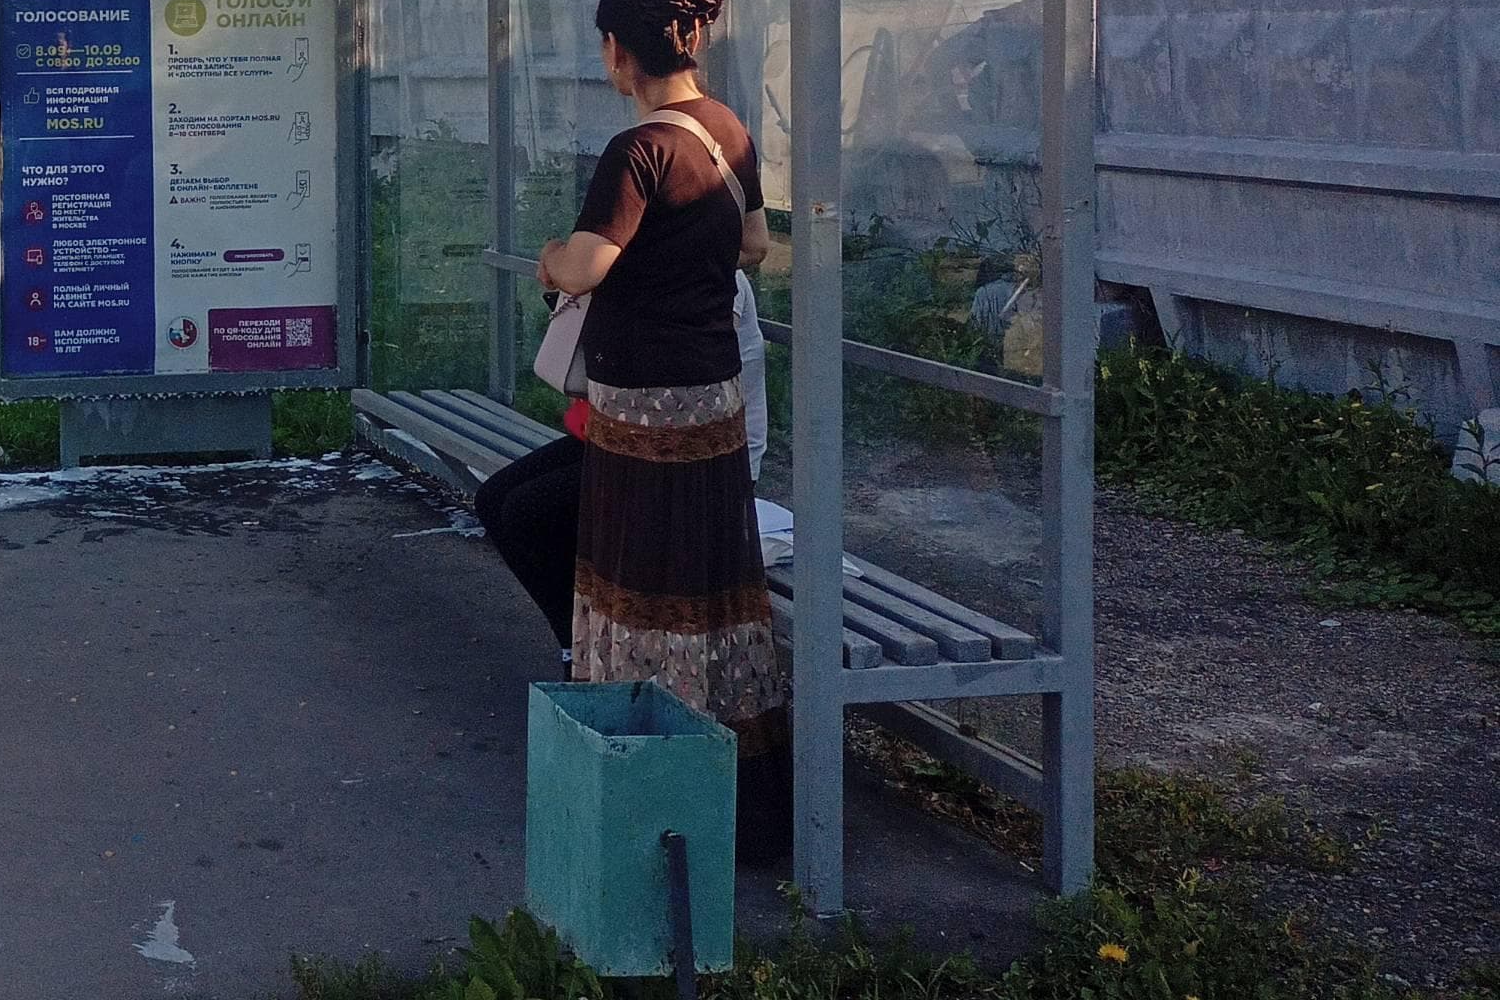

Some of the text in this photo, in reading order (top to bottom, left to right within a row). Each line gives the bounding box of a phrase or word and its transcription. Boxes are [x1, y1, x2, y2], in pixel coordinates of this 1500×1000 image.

[16, 10, 130, 23] ГОЛОСОВАНИЕ
[216, 10, 306, 28] ОНЛАЙН
[168, 44, 178, 55] 1.
[35, 56, 140, 68] С 08:00 ДО 20:00
[46, 86, 119, 95] ВСЯ ПОДРОБНАЯ
[46, 96, 109, 105] ИНФОРМАЦИЯ
[61, 105, 90, 113] САЙТЕ
[168, 103, 181, 114] 2.
[46, 117, 104, 130] MOS.RU
[22, 164, 105, 175] ЧТО ДЛЯ ЭТОГО
[170, 163, 183, 175] 3.
[22, 177, 69, 187] НУЖНО?
[52, 193, 110, 201] ПОСТОЯННАЯ
[52, 201, 112, 209] РЕГИСТРАЦИЯ
[53, 237, 147, 247] ЛЮБОЕ ЭЛЕКТРОННОЕ
[170, 238, 185, 249] 4.
[53, 246, 109, 255] УСТРОЙСТВО
[53, 283, 91, 293] ПОЛНЫЙ
[54, 299, 130, 309] НА САЙТЕ MOS.RU
[54, 328, 117, 337] ВАМ ДОЛЖНО
[54, 336, 120, 346] ИСПОЛНИТЬСЯ
